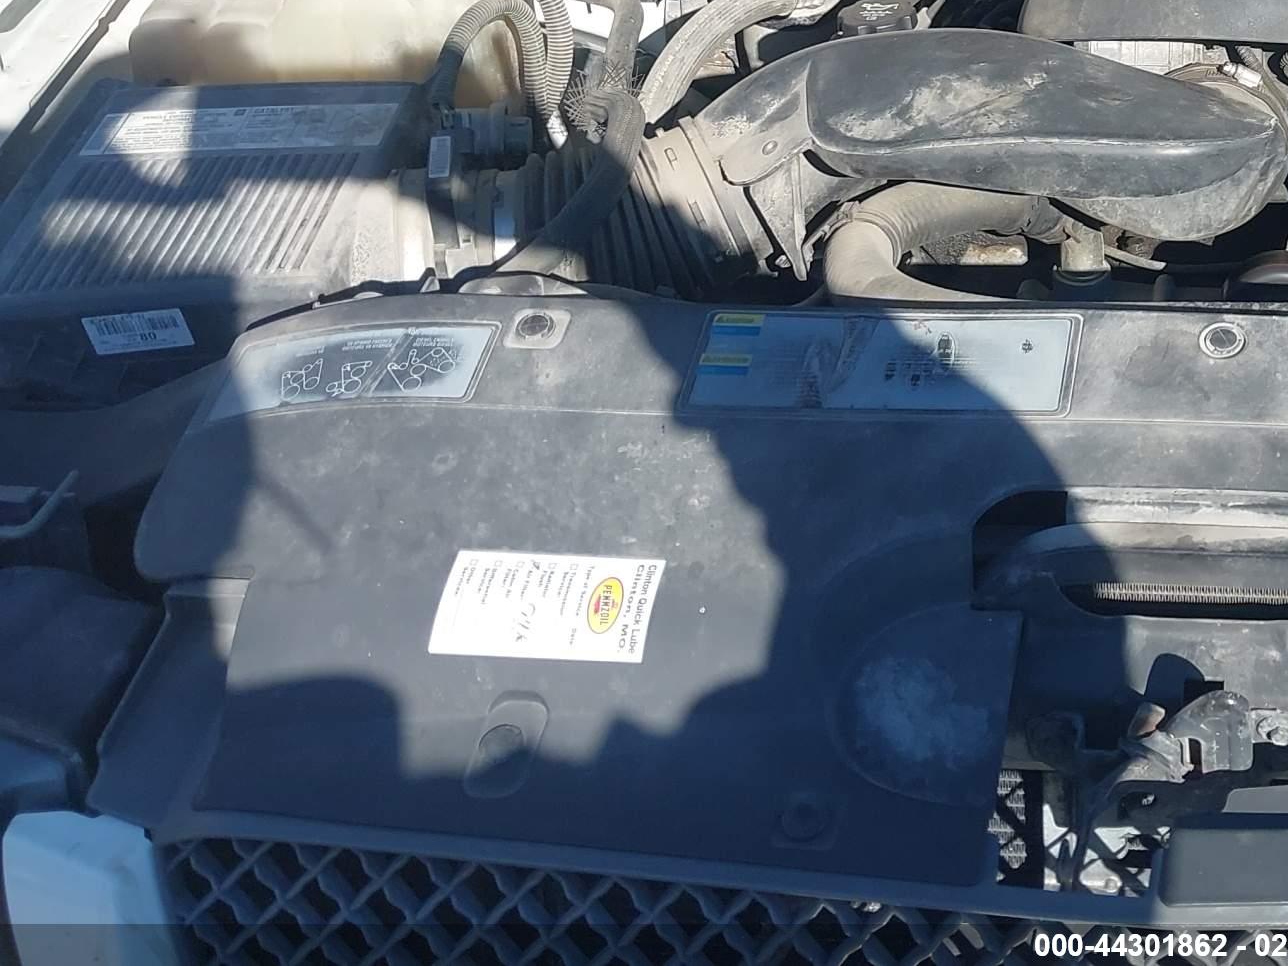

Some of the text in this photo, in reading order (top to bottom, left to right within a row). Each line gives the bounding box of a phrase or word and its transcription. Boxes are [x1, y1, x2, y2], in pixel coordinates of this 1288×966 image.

[599, 584, 613, 626] PENNZOIL
[617, 564, 645, 653] Clinton, MO.
[628, 564, 657, 654] Clinton Quick Lube
